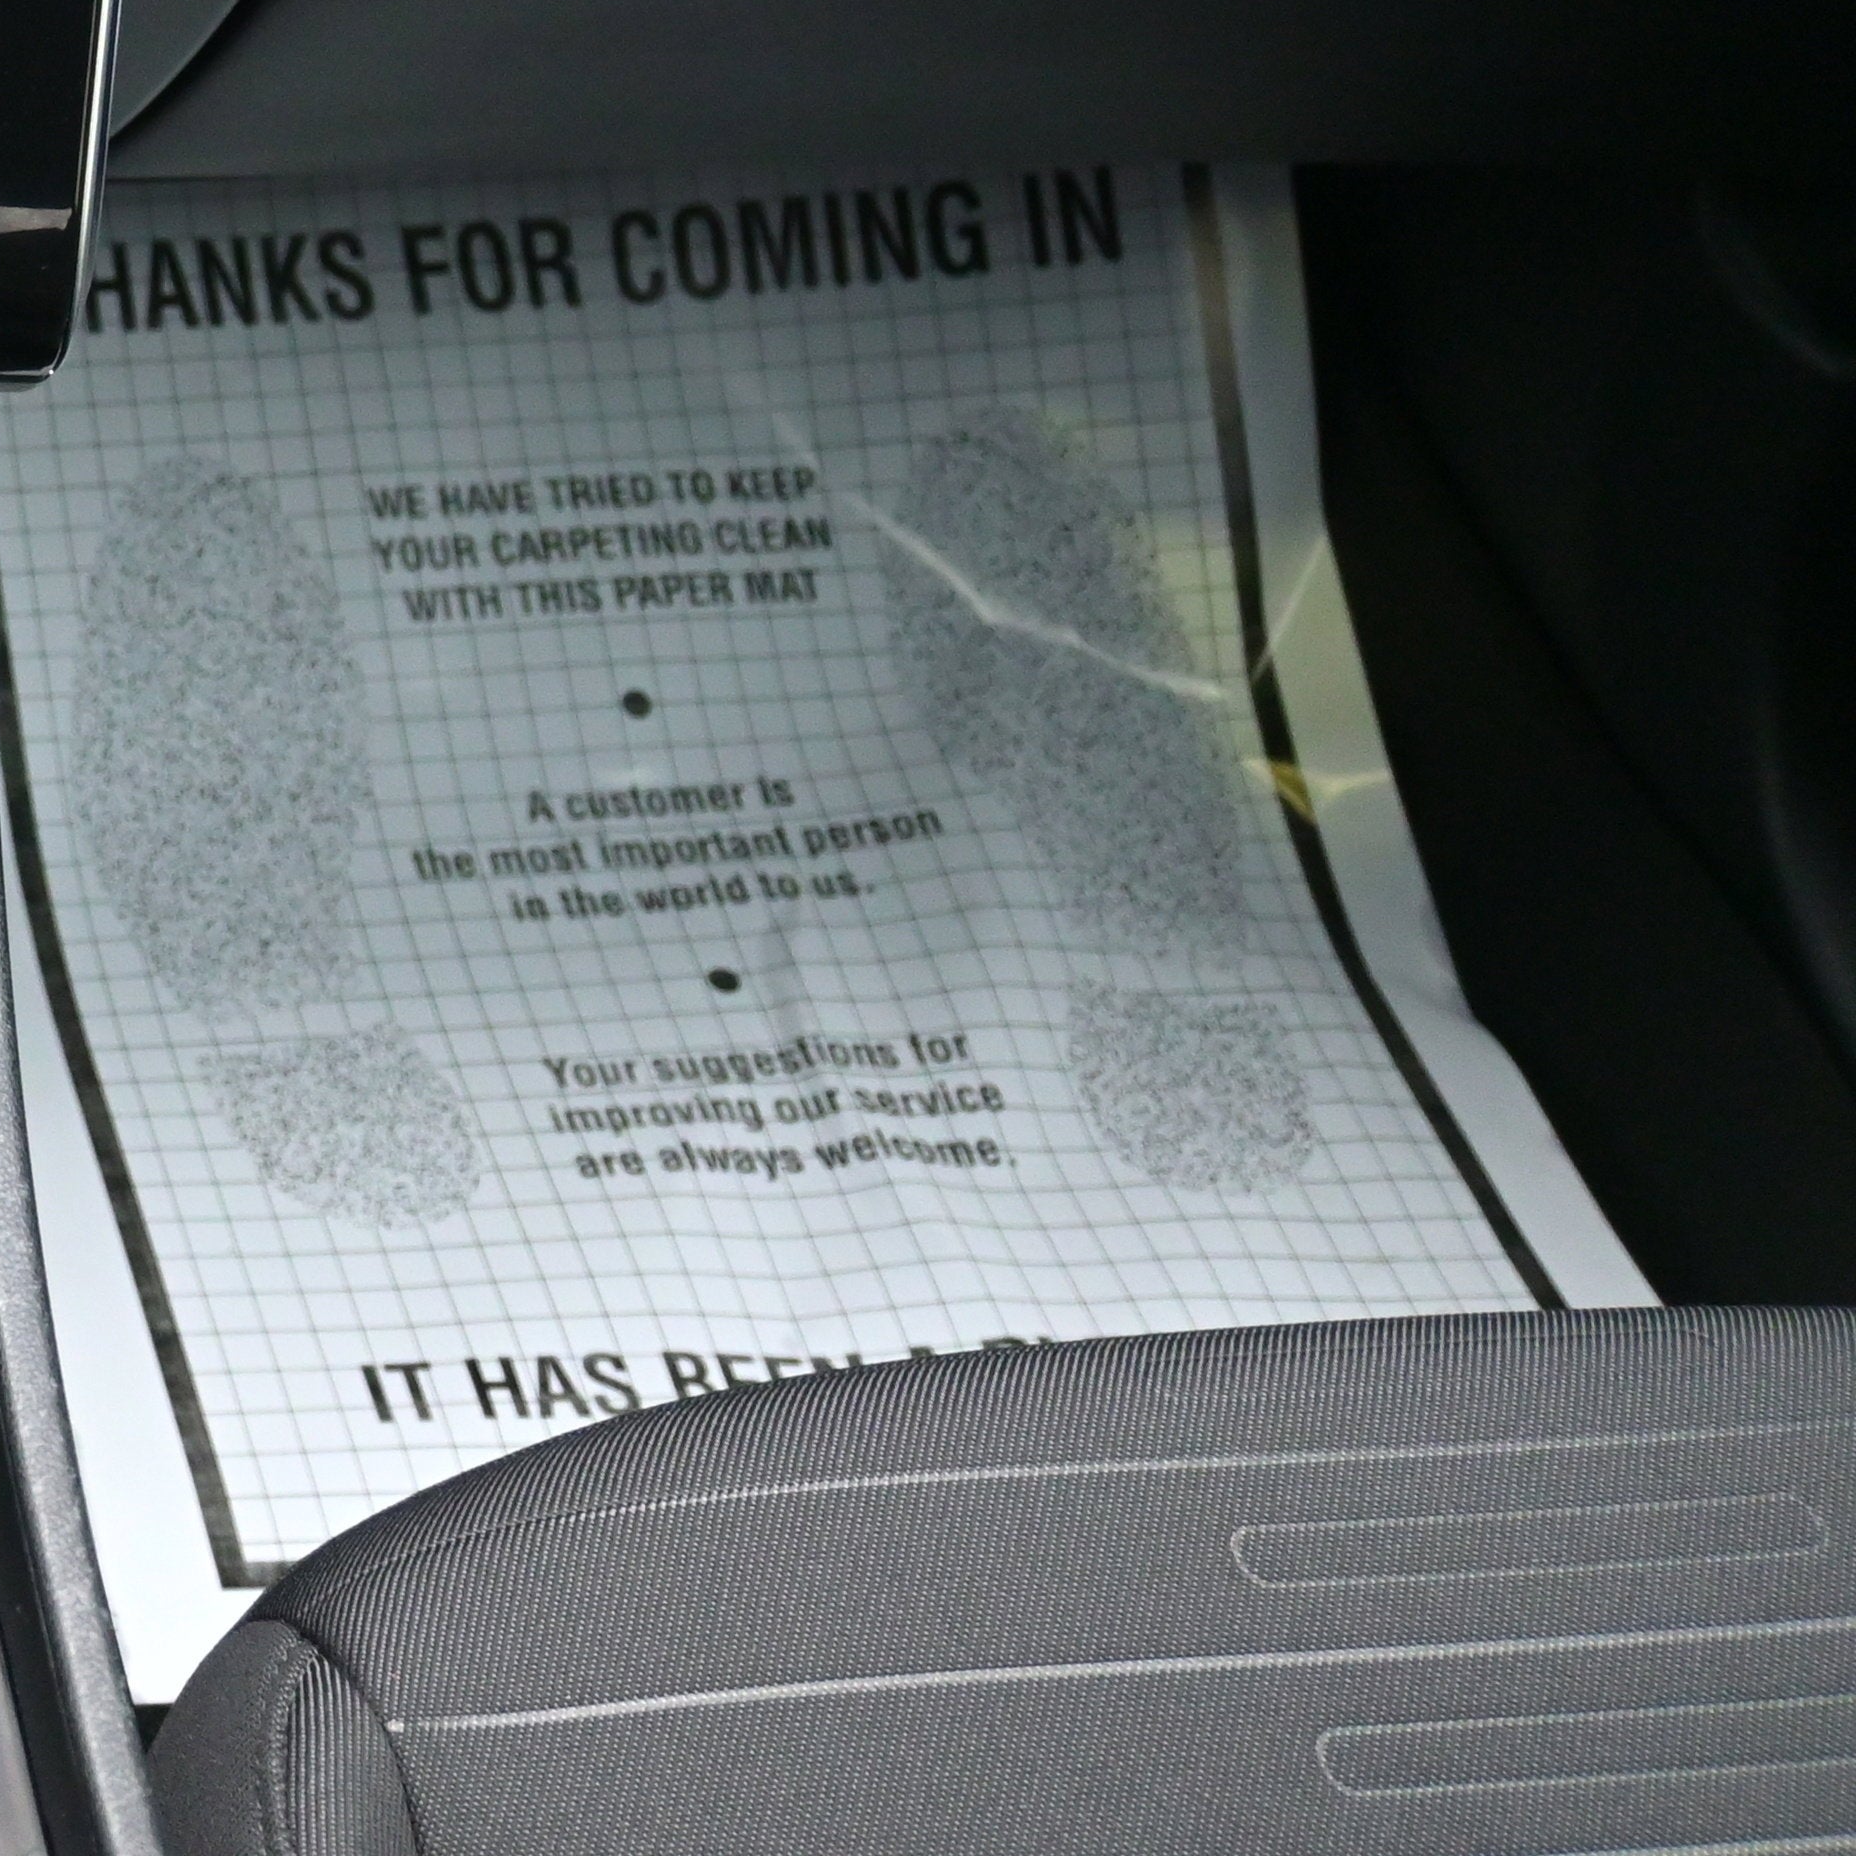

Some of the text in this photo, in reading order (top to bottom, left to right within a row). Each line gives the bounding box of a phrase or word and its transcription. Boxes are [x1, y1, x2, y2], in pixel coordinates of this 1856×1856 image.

[86, 165, 1123, 335] HANKS FOR COMING IN
[369, 466, 817, 519] WE HAVE TRIED TO KEEP
[371, 516, 832, 574] YOUR CARPETING CLEAN
[403, 568, 819, 622] WITH THIS PAPER MAT
[527, 776, 795, 823] A customer is
[412, 807, 944, 881] the most important person
[513, 870, 876, 921] in the world to us.
[543, 1032, 968, 1089] Your suggestions for
[549, 1080, 1006, 1136] improving our service
[574, 1152, 645, 1178] are
[659, 1142, 805, 1181] always
[361, 1362, 432, 1423] IT
[465, 1353, 642, 1419] HAS
